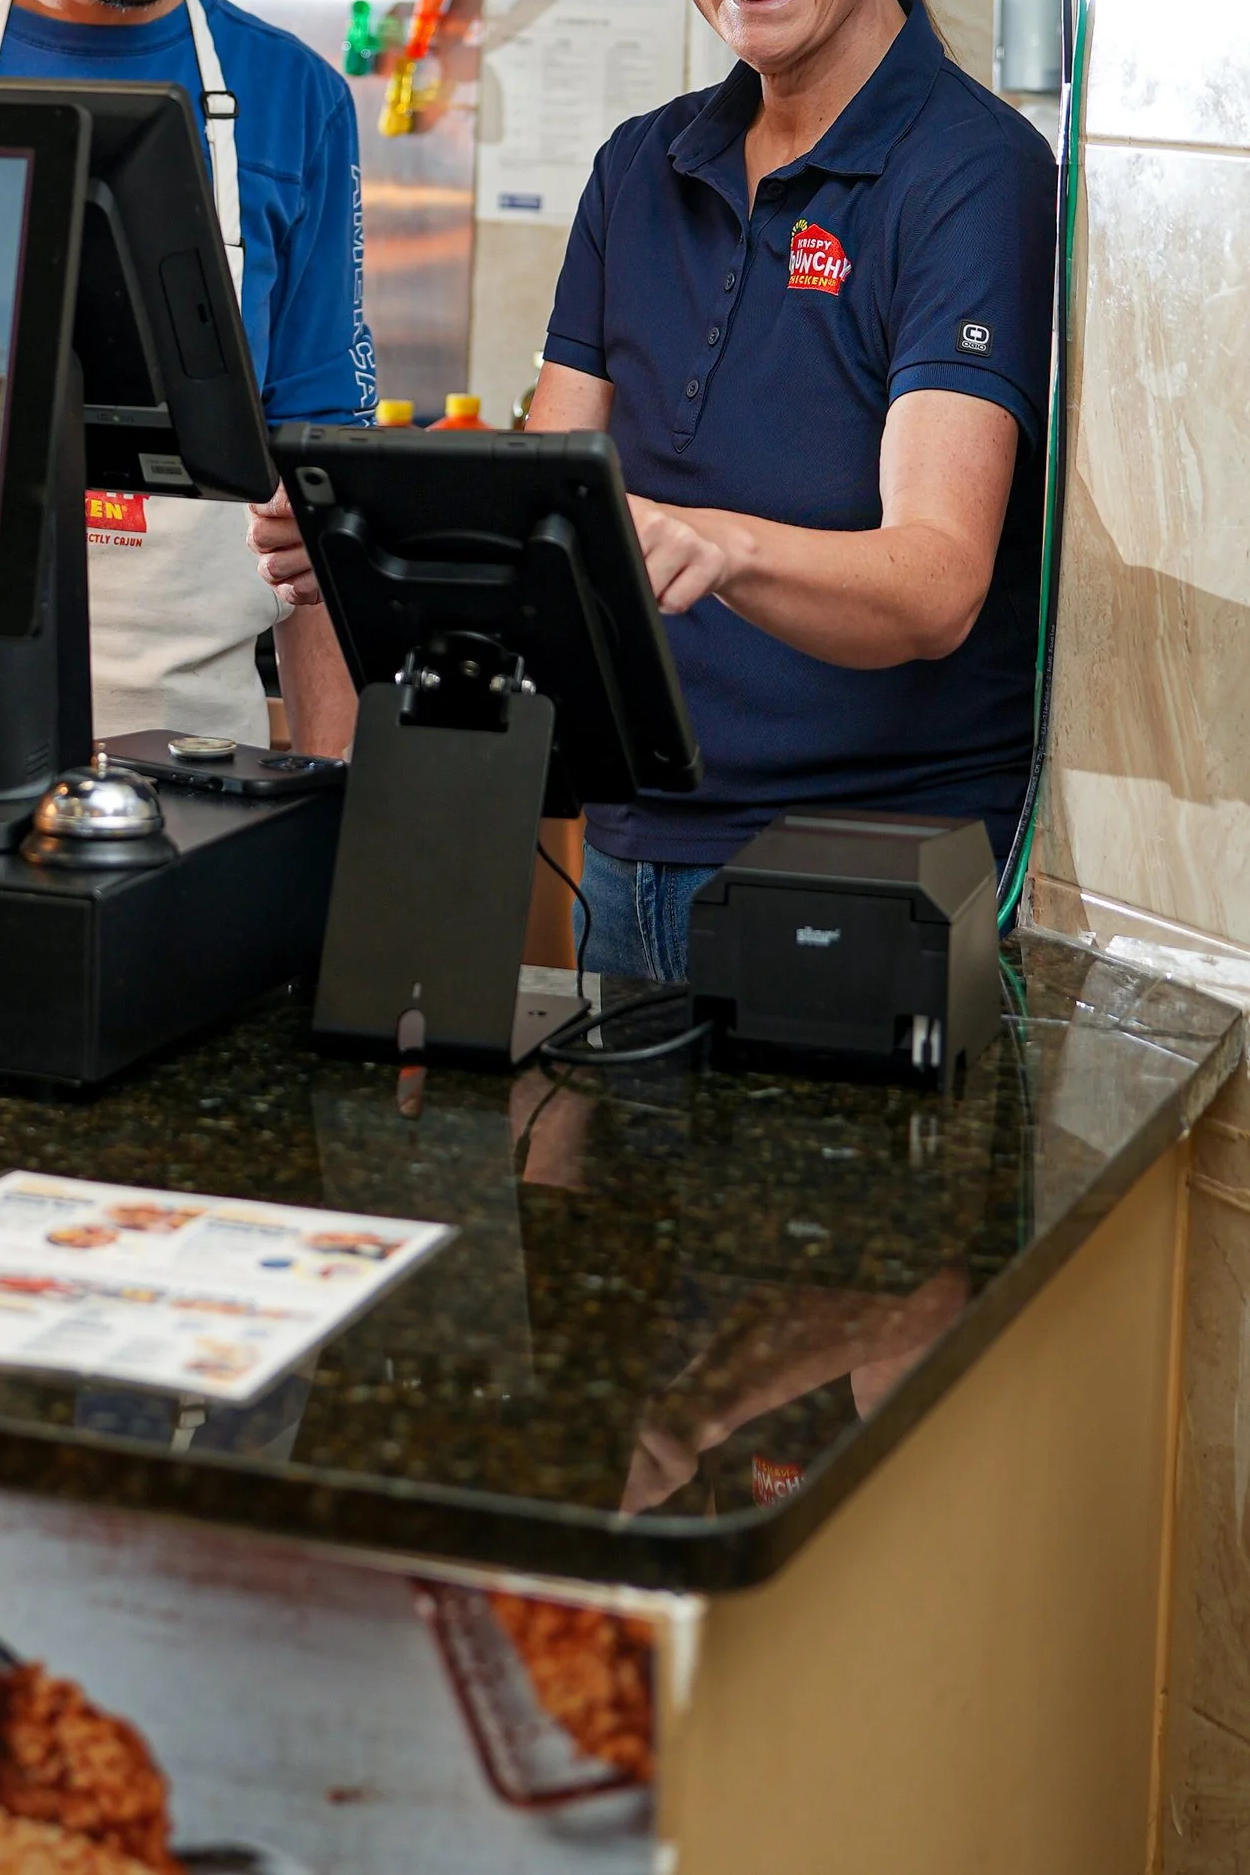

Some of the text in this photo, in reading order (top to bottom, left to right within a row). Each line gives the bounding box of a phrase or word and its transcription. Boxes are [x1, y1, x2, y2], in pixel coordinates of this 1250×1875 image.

[798, 238, 832, 250] KRISPY
[789, 248, 852, 279] UNCHY
[88, 498, 123, 520] EN
[87, 532, 143, 548] CTLY CAJUN
